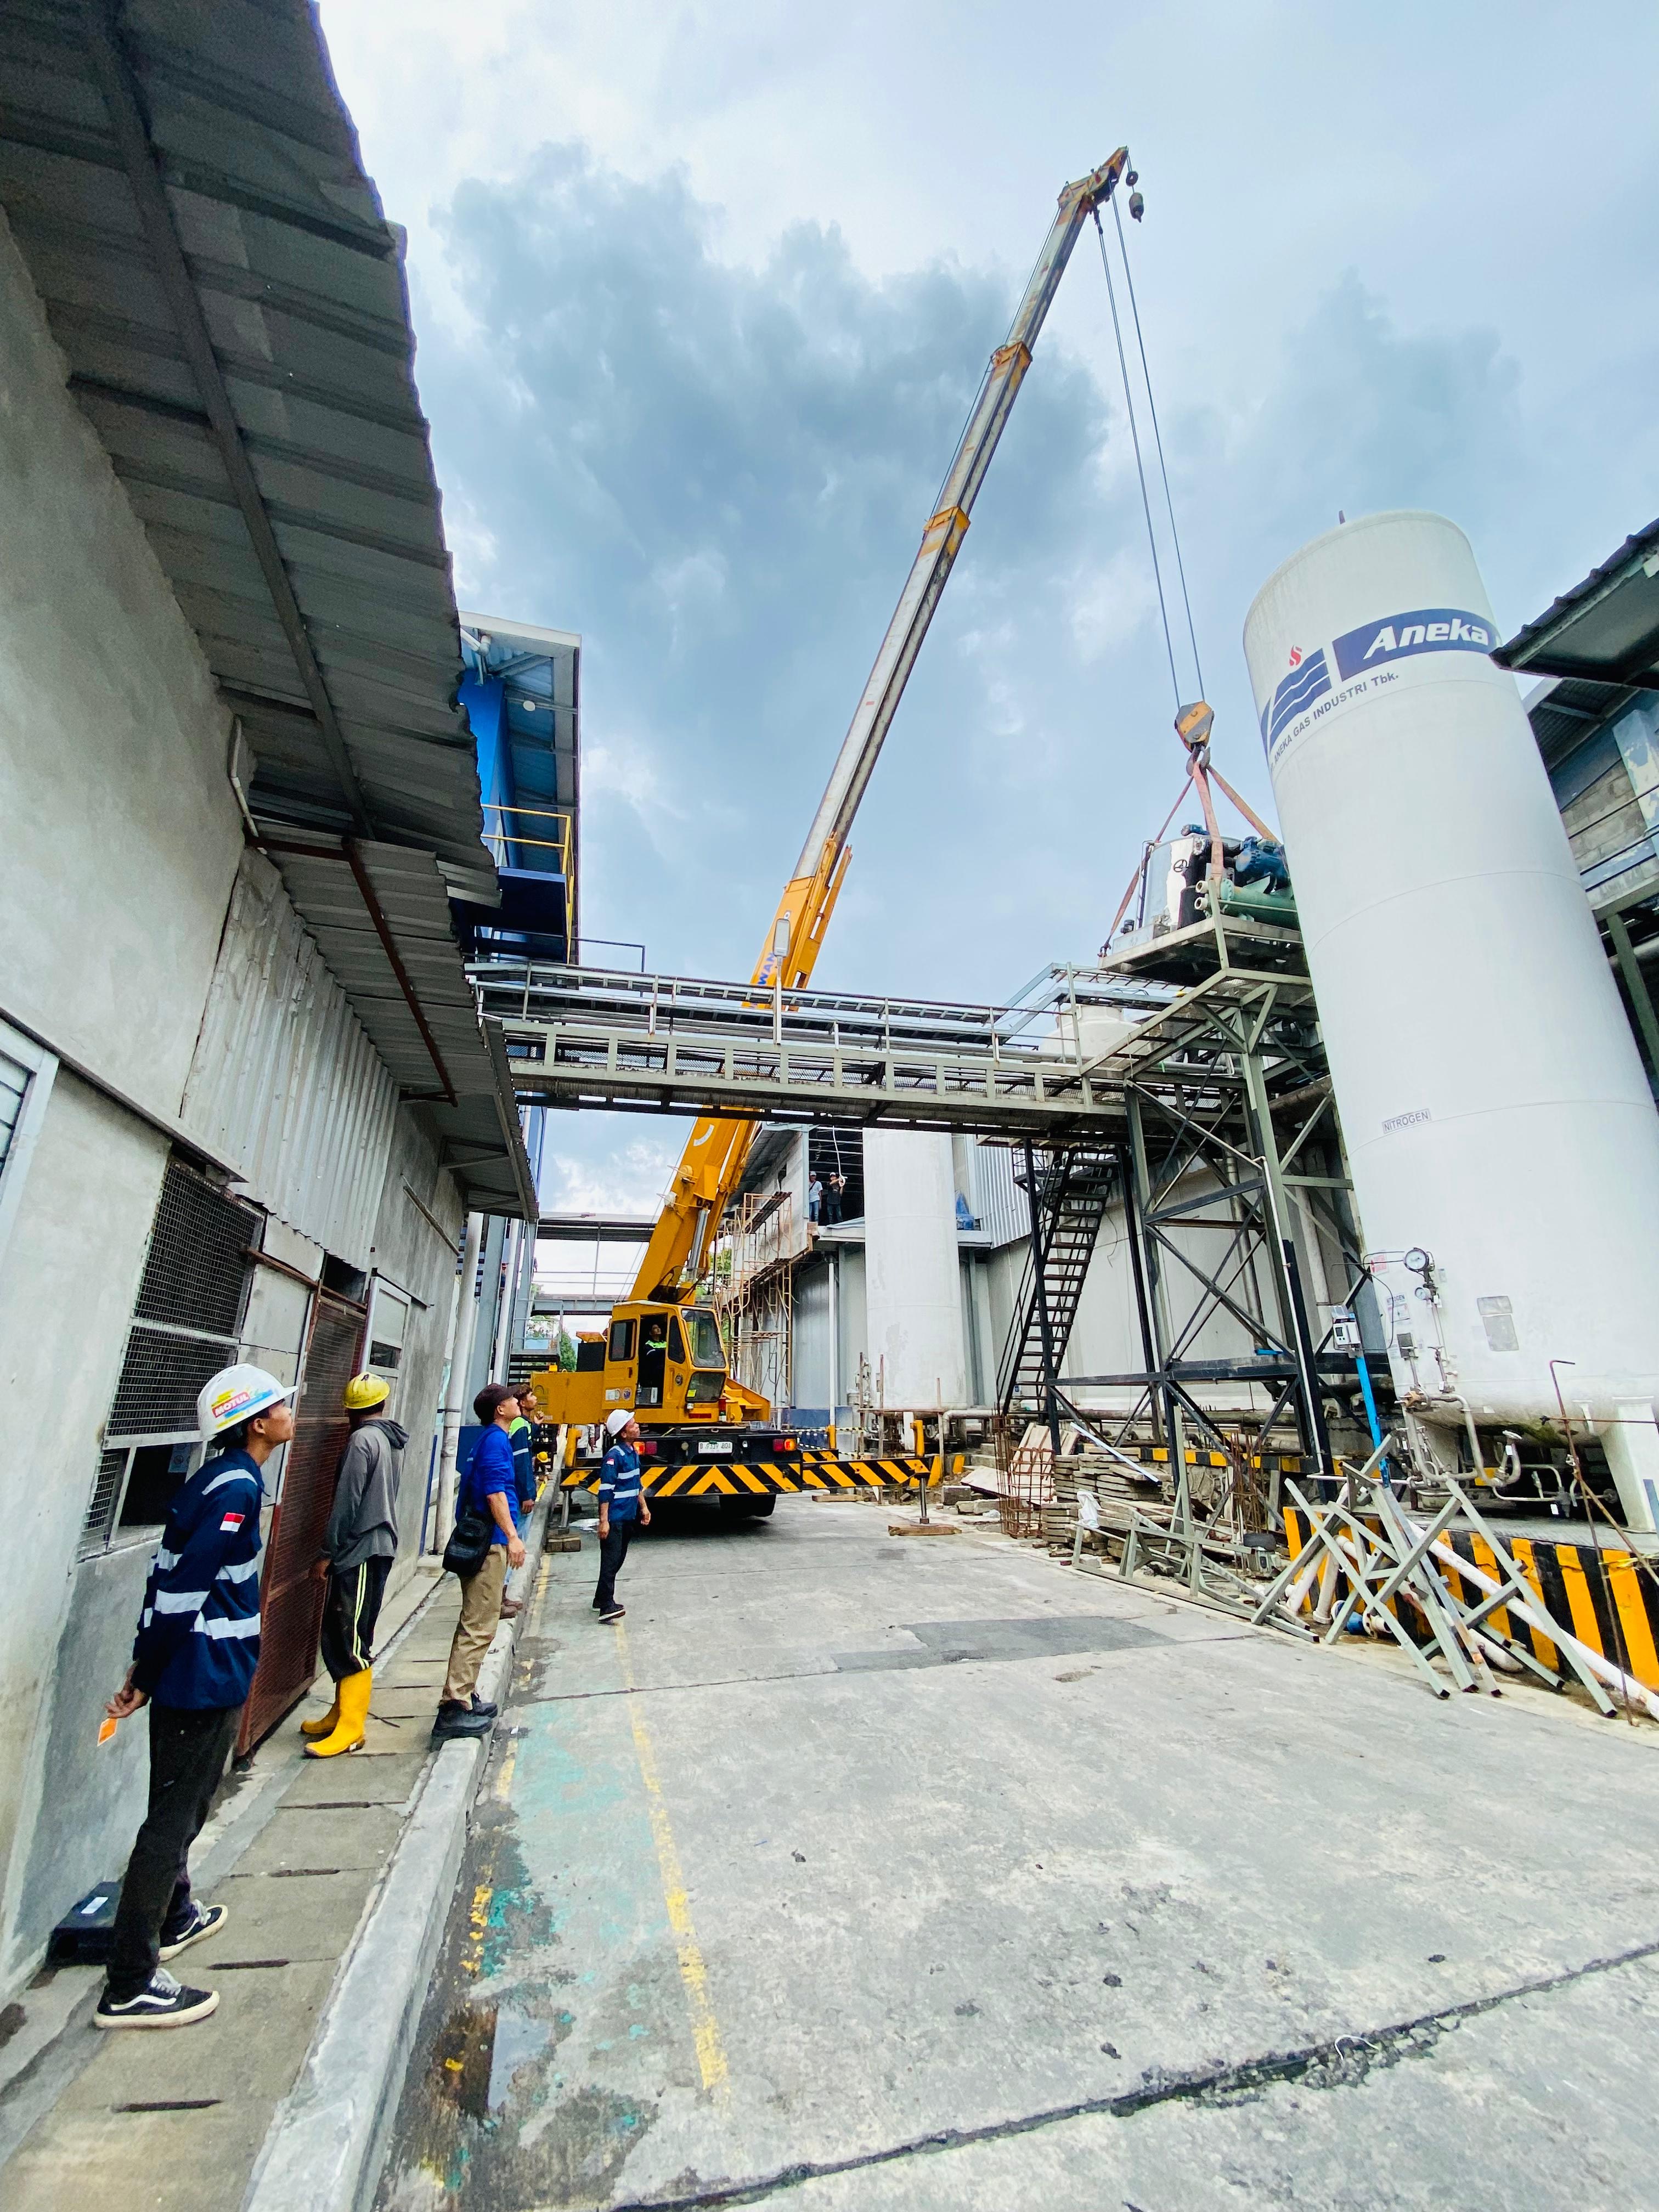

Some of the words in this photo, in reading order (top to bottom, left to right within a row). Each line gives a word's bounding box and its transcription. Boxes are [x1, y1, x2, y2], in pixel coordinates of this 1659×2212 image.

[1363, 618, 1488, 659] Aneka
[1274, 734, 1293, 765] ANEKA
[1293, 716, 1311, 736] GAS
[1313, 681, 1368, 720] INDUSTRI
[1371, 672, 1399, 686] Tbk.
[1384, 1110, 1429, 1131] NITROGEN
[215, 1394, 250, 1417] MOTUL
